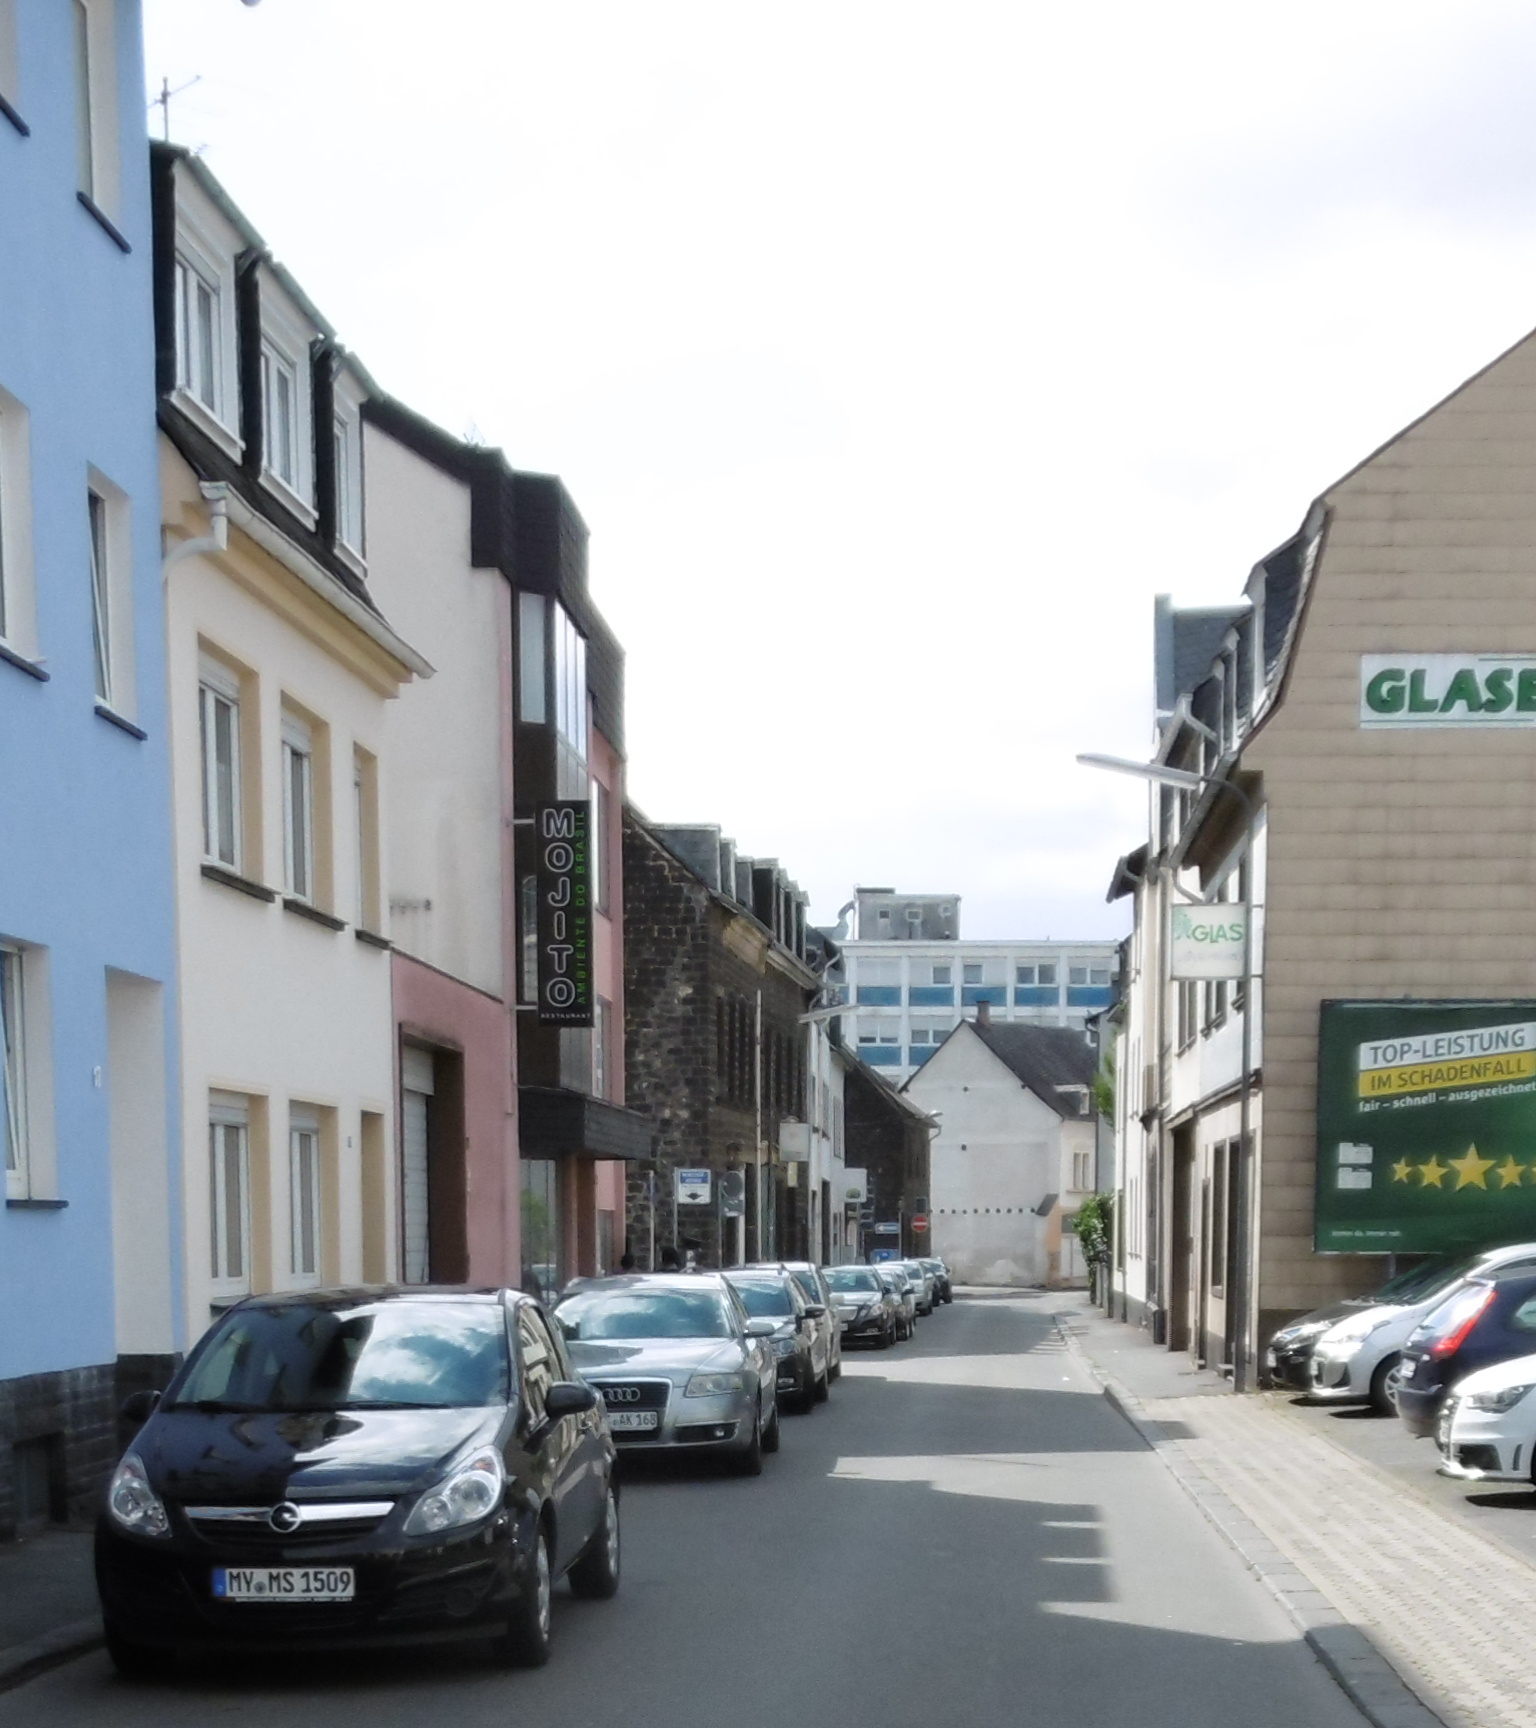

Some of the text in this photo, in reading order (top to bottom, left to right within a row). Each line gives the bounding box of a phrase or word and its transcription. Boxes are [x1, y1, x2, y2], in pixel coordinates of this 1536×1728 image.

[543, 808, 576, 1007] MOJITO
[576, 811, 586, 1004] AMBIENTE DO BRASIL
[1192, 923, 1243, 943] GLAS
[1369, 1028, 1526, 1064] TOP-LEISTUNG
[1370, 1058, 1527, 1090] IM SCHADENFALL
[1359, 1100, 1381, 1112] fair
[1393, 1092, 1436, 1109] schnell
[1448, 1081, 1536, 1102] ausgezeichnet
[301, 1571, 352, 1593] 1509
